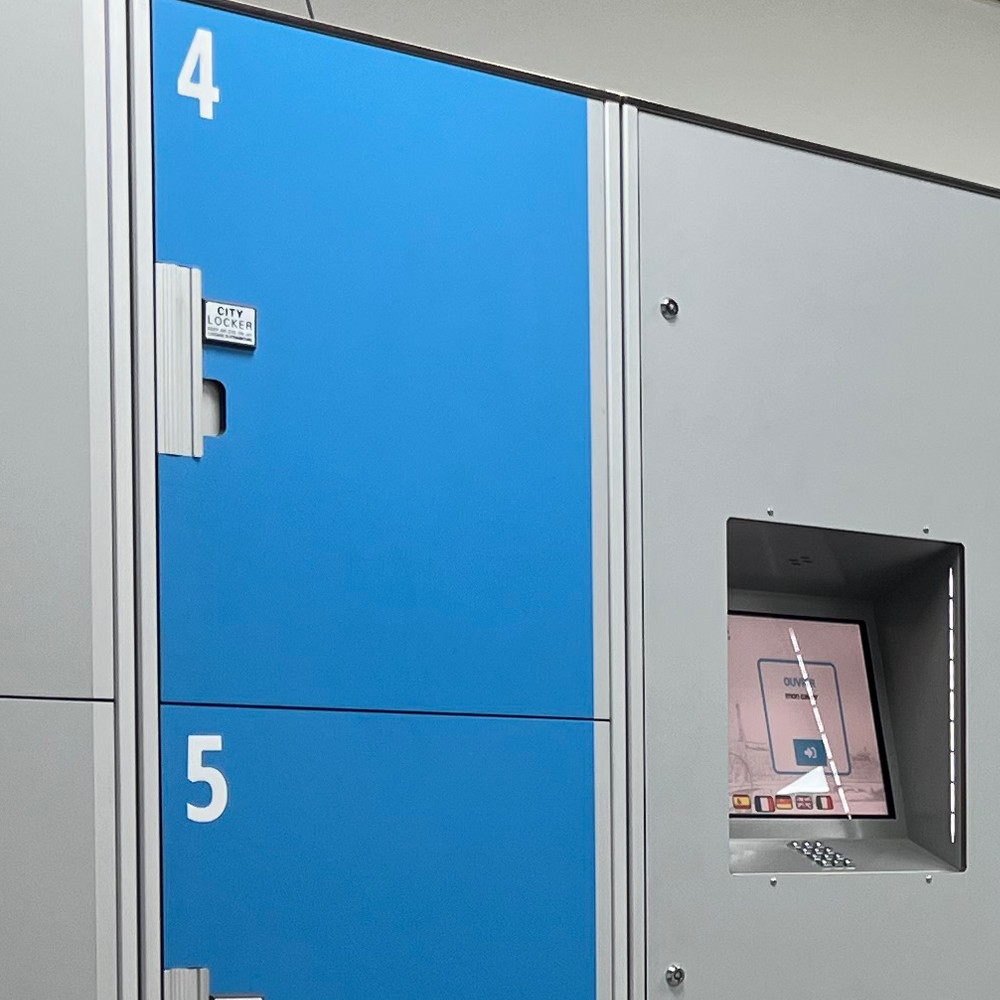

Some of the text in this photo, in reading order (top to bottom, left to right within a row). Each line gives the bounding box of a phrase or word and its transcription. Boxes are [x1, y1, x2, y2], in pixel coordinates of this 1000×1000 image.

[177, 28, 220, 120] 4
[217, 306, 243, 318] CITY
[207, 315, 253, 331] LOCKER
[783, 677, 816, 688] OUVRR
[186, 734, 228, 823] 5
